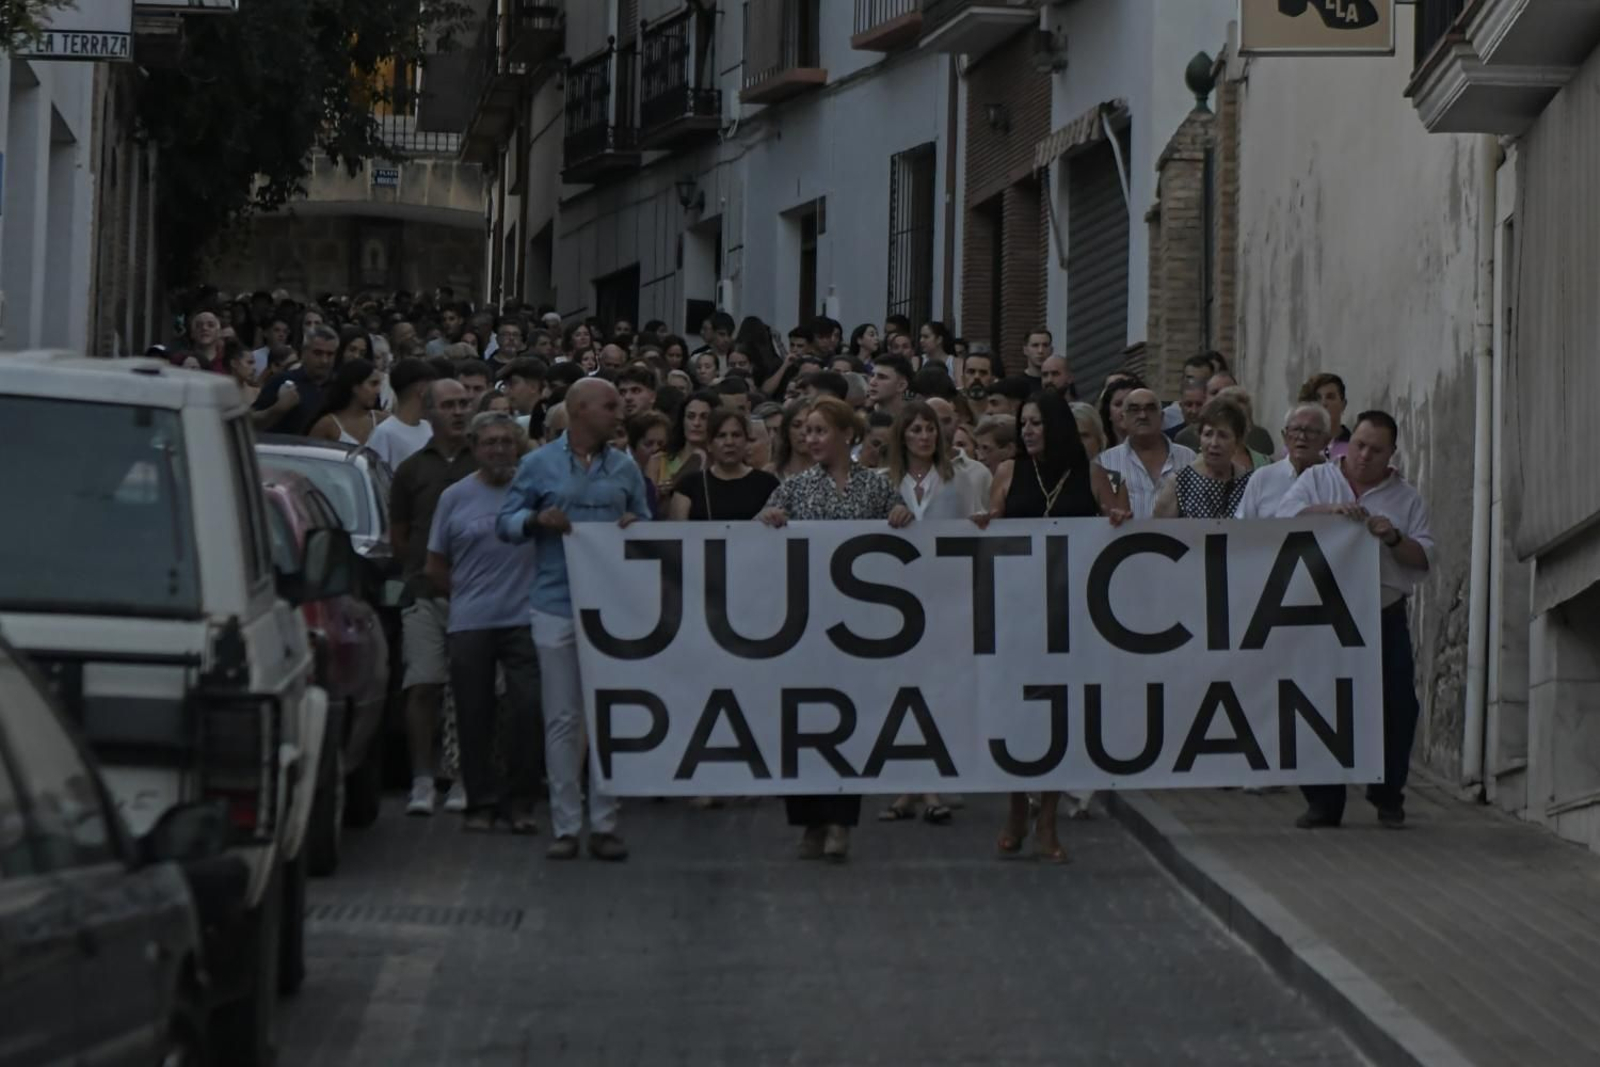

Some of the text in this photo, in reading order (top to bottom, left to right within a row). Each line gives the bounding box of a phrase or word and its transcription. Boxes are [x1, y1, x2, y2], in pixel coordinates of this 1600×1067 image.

[36, 34, 128, 56] LA TERRAZA
[580, 531, 1366, 660] JUSTICIA
[595, 678, 1355, 780] PARA JUAN
